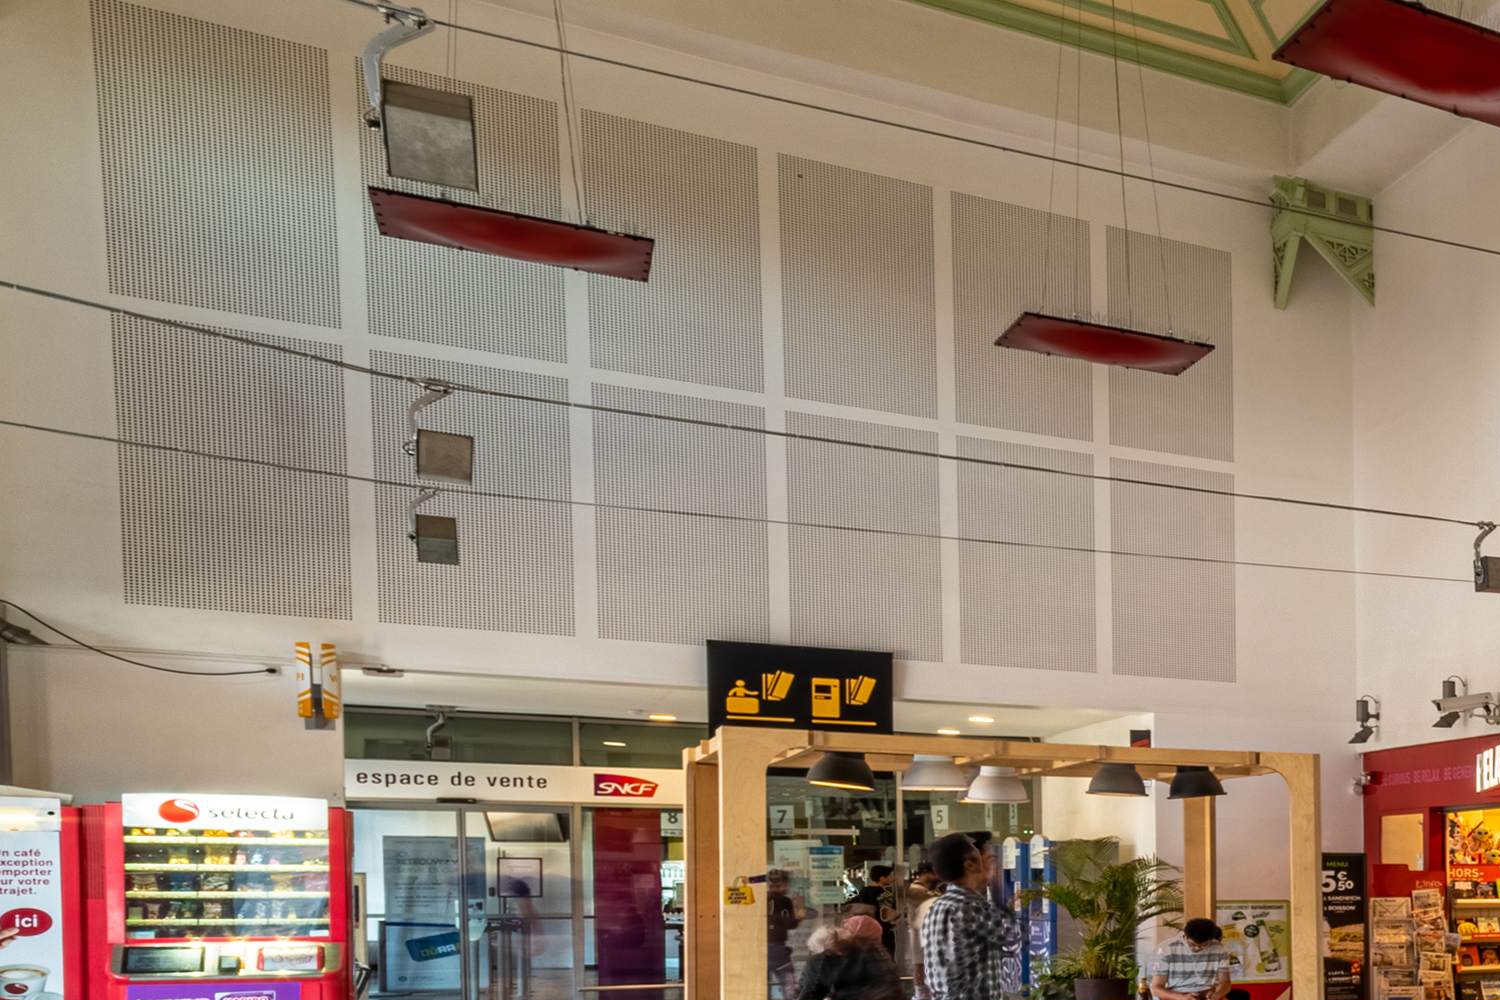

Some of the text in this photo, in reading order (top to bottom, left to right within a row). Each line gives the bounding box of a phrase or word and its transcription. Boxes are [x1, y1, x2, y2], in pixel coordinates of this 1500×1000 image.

[356, 771, 548, 789] espace de vente
[1413, 770, 1421, 784] BE
[1421, 768, 1440, 783] RELAX
[1443, 766, 1453, 780] BE
[596, 781, 655, 795] SNCF
[208, 807, 294, 820] selecta
[667, 812, 678, 824] 8
[776, 809, 787, 824] 7
[936, 809, 943, 824] 5
[0, 849, 41, 857] n café
[14, 914, 38, 928] ici
